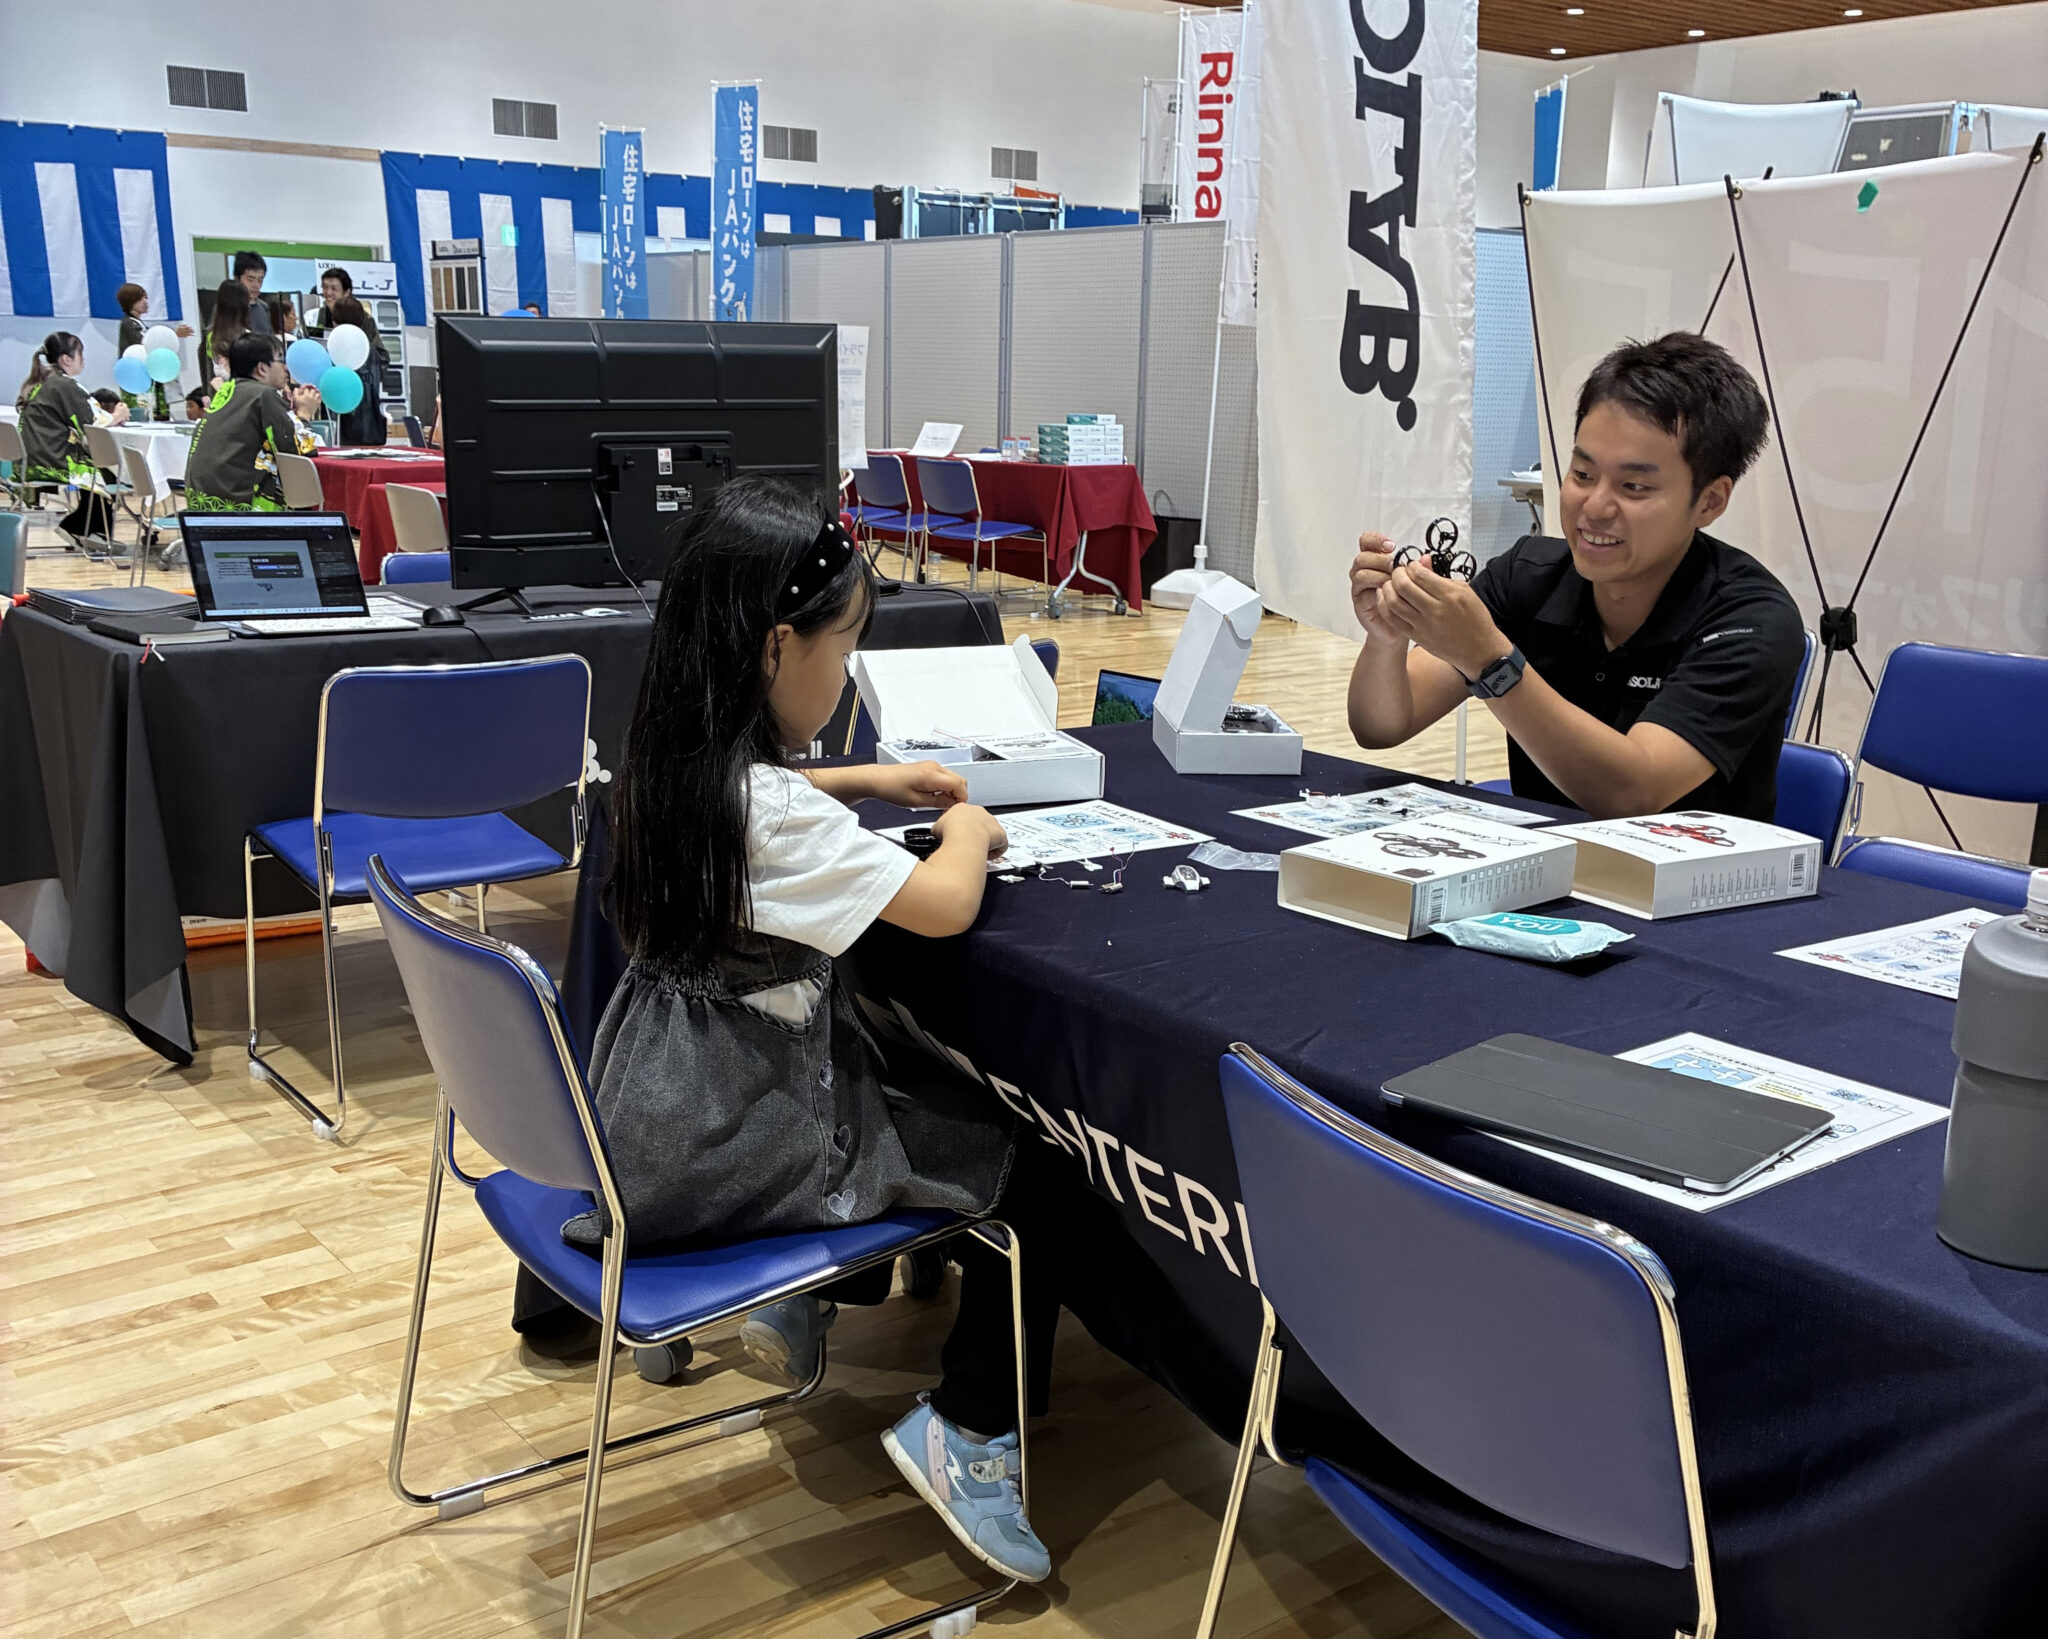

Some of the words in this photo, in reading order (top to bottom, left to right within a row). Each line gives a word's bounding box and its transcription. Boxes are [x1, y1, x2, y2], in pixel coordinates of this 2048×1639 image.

[738, 100, 754, 259] 住宅ローンは
[1194, 51, 1234, 219] Rinna
[622, 143, 639, 290] 住宅ローンは
[720, 168, 740, 305] JAバンク
